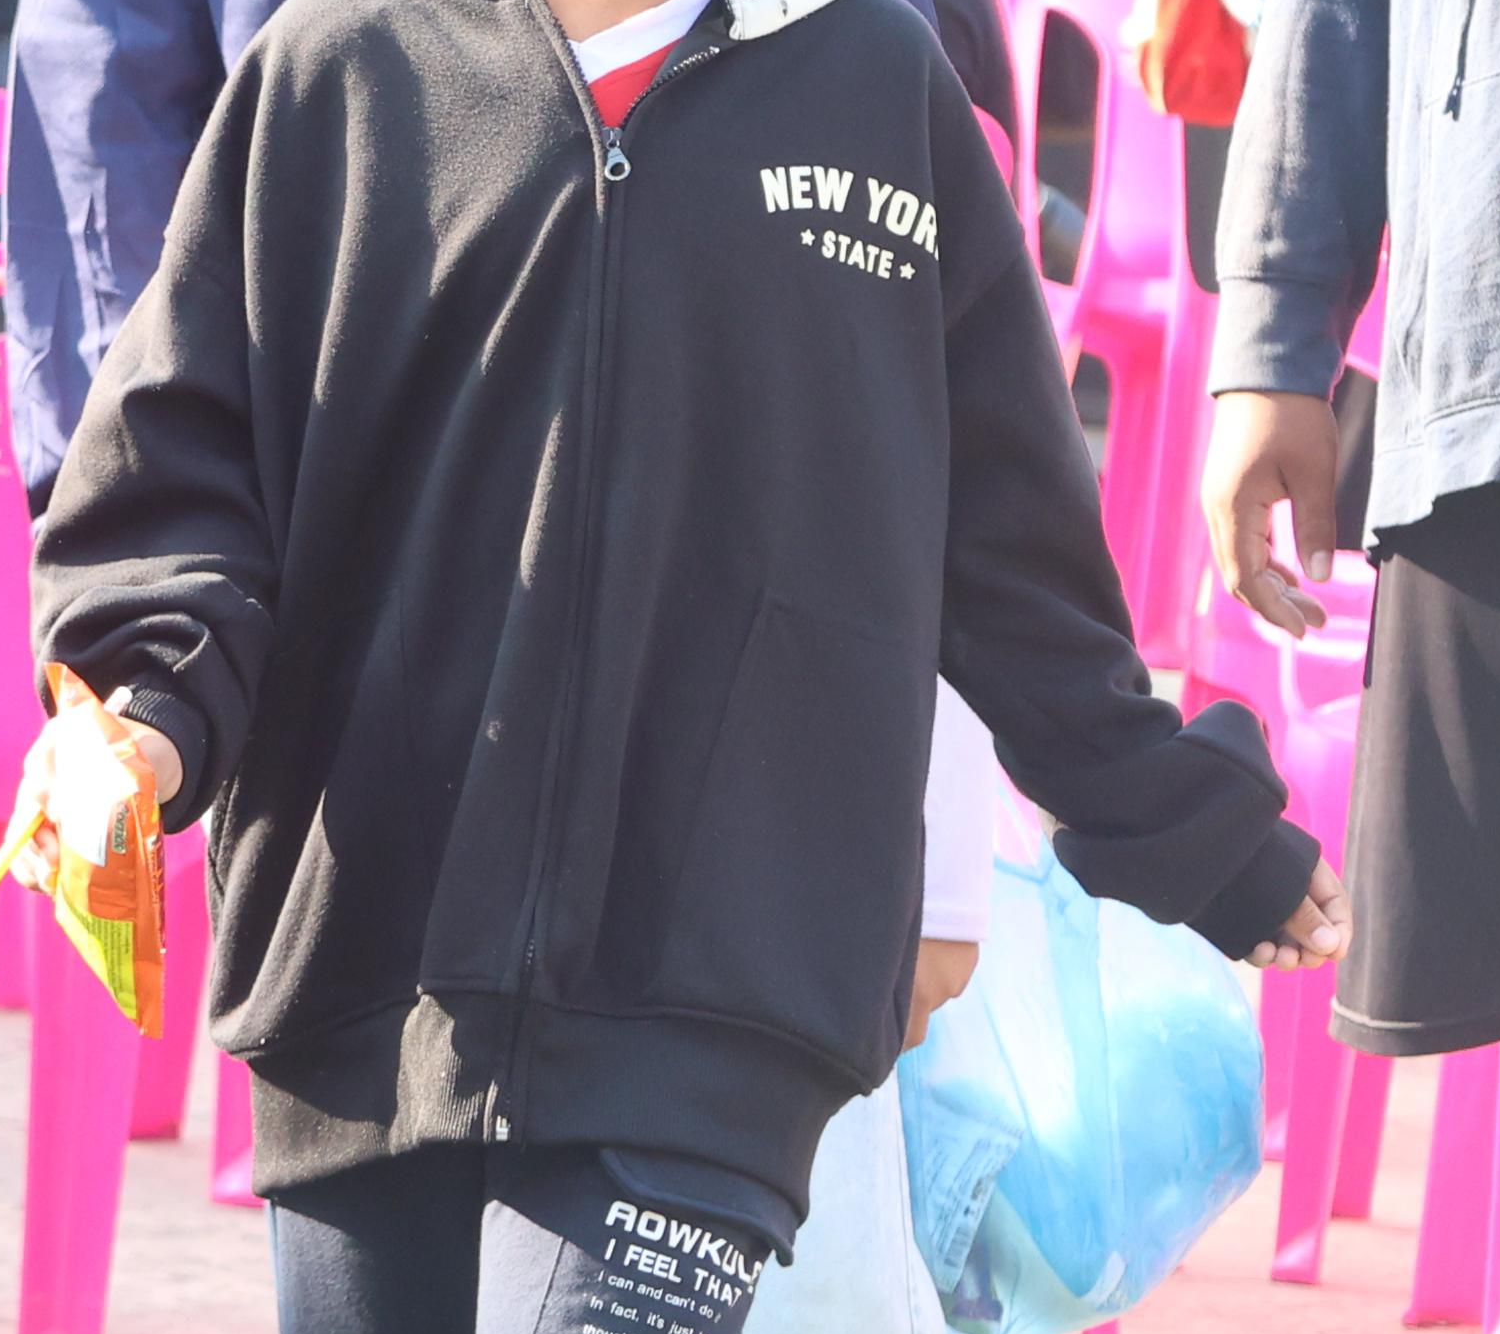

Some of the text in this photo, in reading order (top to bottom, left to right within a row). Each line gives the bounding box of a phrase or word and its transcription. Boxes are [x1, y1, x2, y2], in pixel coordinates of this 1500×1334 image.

[760, 165, 939, 261] NEW YOR
[821, 230, 894, 279] STATE
[597, 1269, 714, 1318] I can and can't do
[604, 1238, 742, 1308] I FEEL THAT
[590, 1297, 604, 1312] In
[610, 1302, 640, 1323] fact,
[646, 1312, 665, 1329] it's
